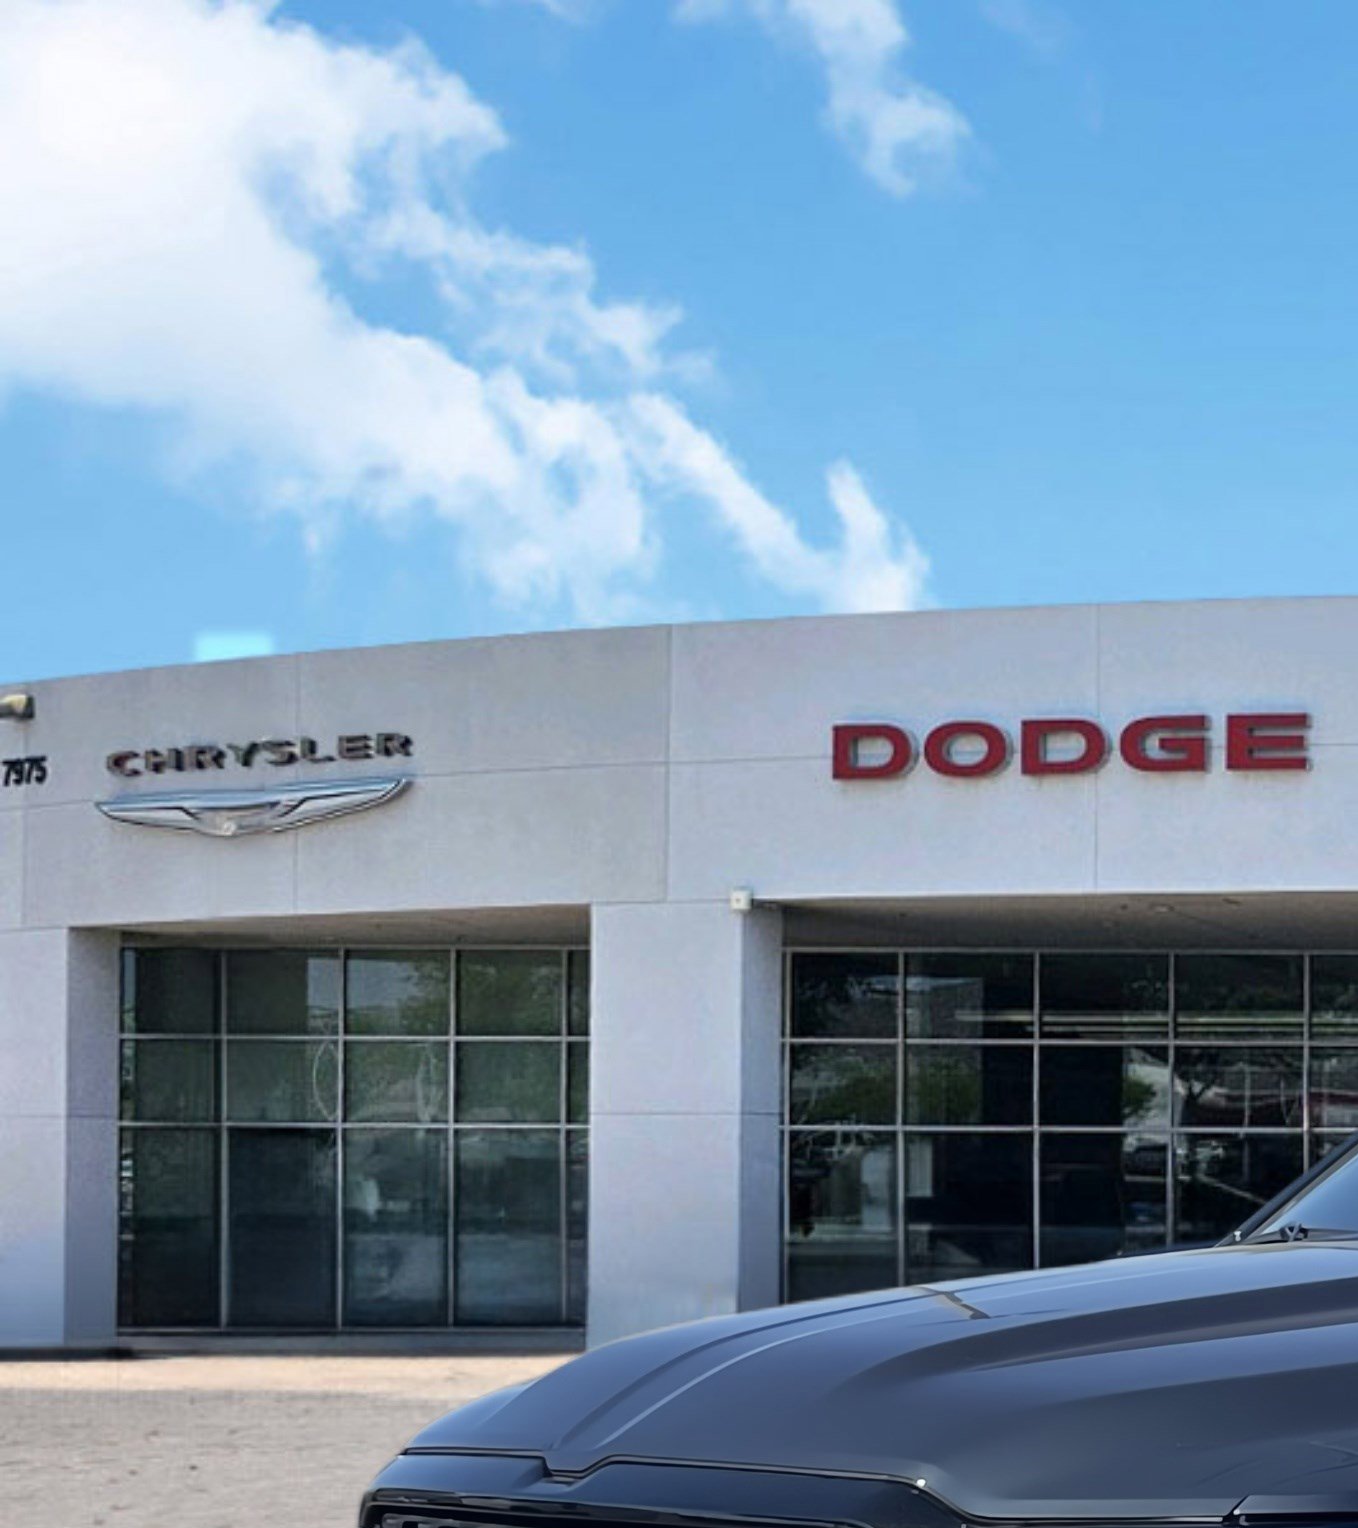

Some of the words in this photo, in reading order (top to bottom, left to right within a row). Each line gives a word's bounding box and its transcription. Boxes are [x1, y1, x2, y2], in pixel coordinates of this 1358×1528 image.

[106, 732, 413, 777] CHRYSLER
[832, 712, 1312, 780] DODGE
[2, 755, 47, 786] 7975
